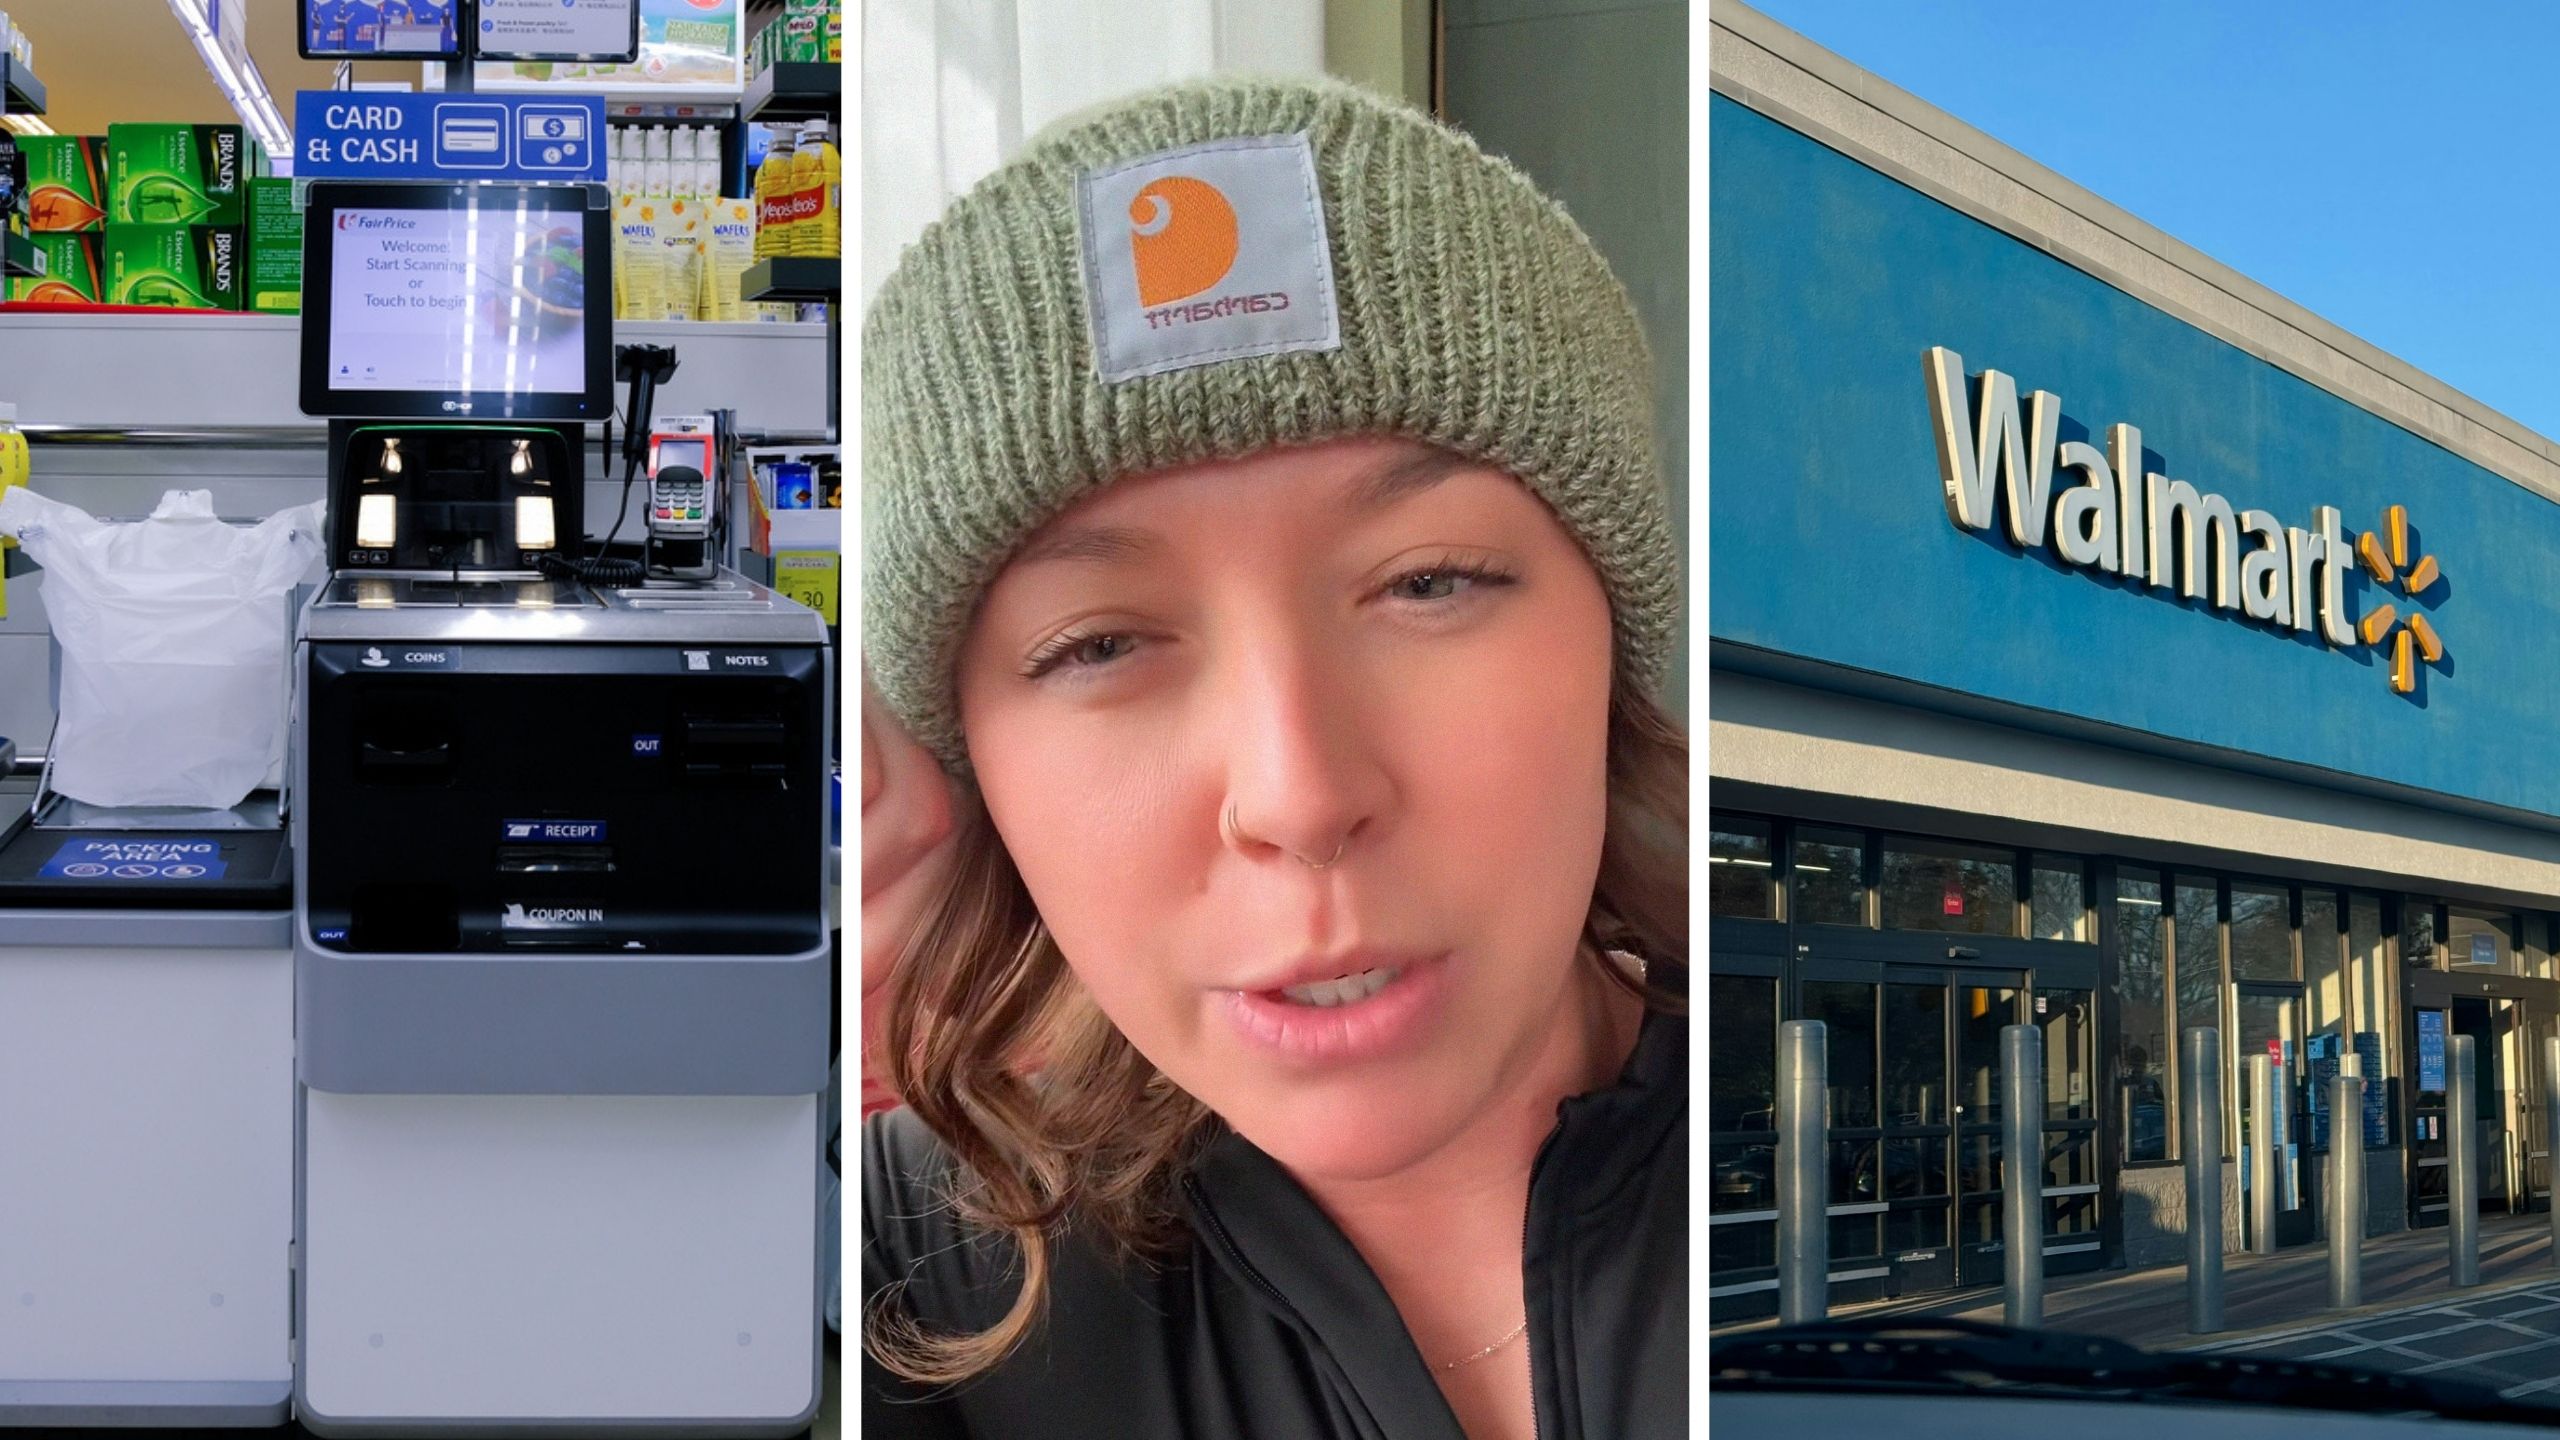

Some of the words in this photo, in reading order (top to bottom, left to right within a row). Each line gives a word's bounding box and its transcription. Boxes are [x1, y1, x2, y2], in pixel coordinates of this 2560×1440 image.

[325, 104, 403, 131] CARD
[307, 139, 332, 163] &
[341, 139, 419, 164] CASH
[358, 216, 417, 230] FairPrice
[621, 224, 656, 238] WAFERS
[713, 224, 750, 237] WAFERS
[366, 257, 400, 271] Start
[403, 257, 467, 274] Scanning
[408, 278, 425, 289] or
[364, 293, 406, 308] Touch
[410, 295, 426, 308] to
[428, 295, 467, 311] begin
[1922, 346, 2357, 647] Walmart
[404, 652, 447, 664] COINS
[725, 655, 769, 667] NOTES
[633, 739, 660, 751] OUT
[545, 824, 598, 838] RECEIPT
[86, 844, 212, 853] PACKING
[103, 853, 182, 861] AREA
[529, 908, 587, 922] COUPON
[588, 908, 604, 922] IN
[320, 931, 346, 940] OUT
